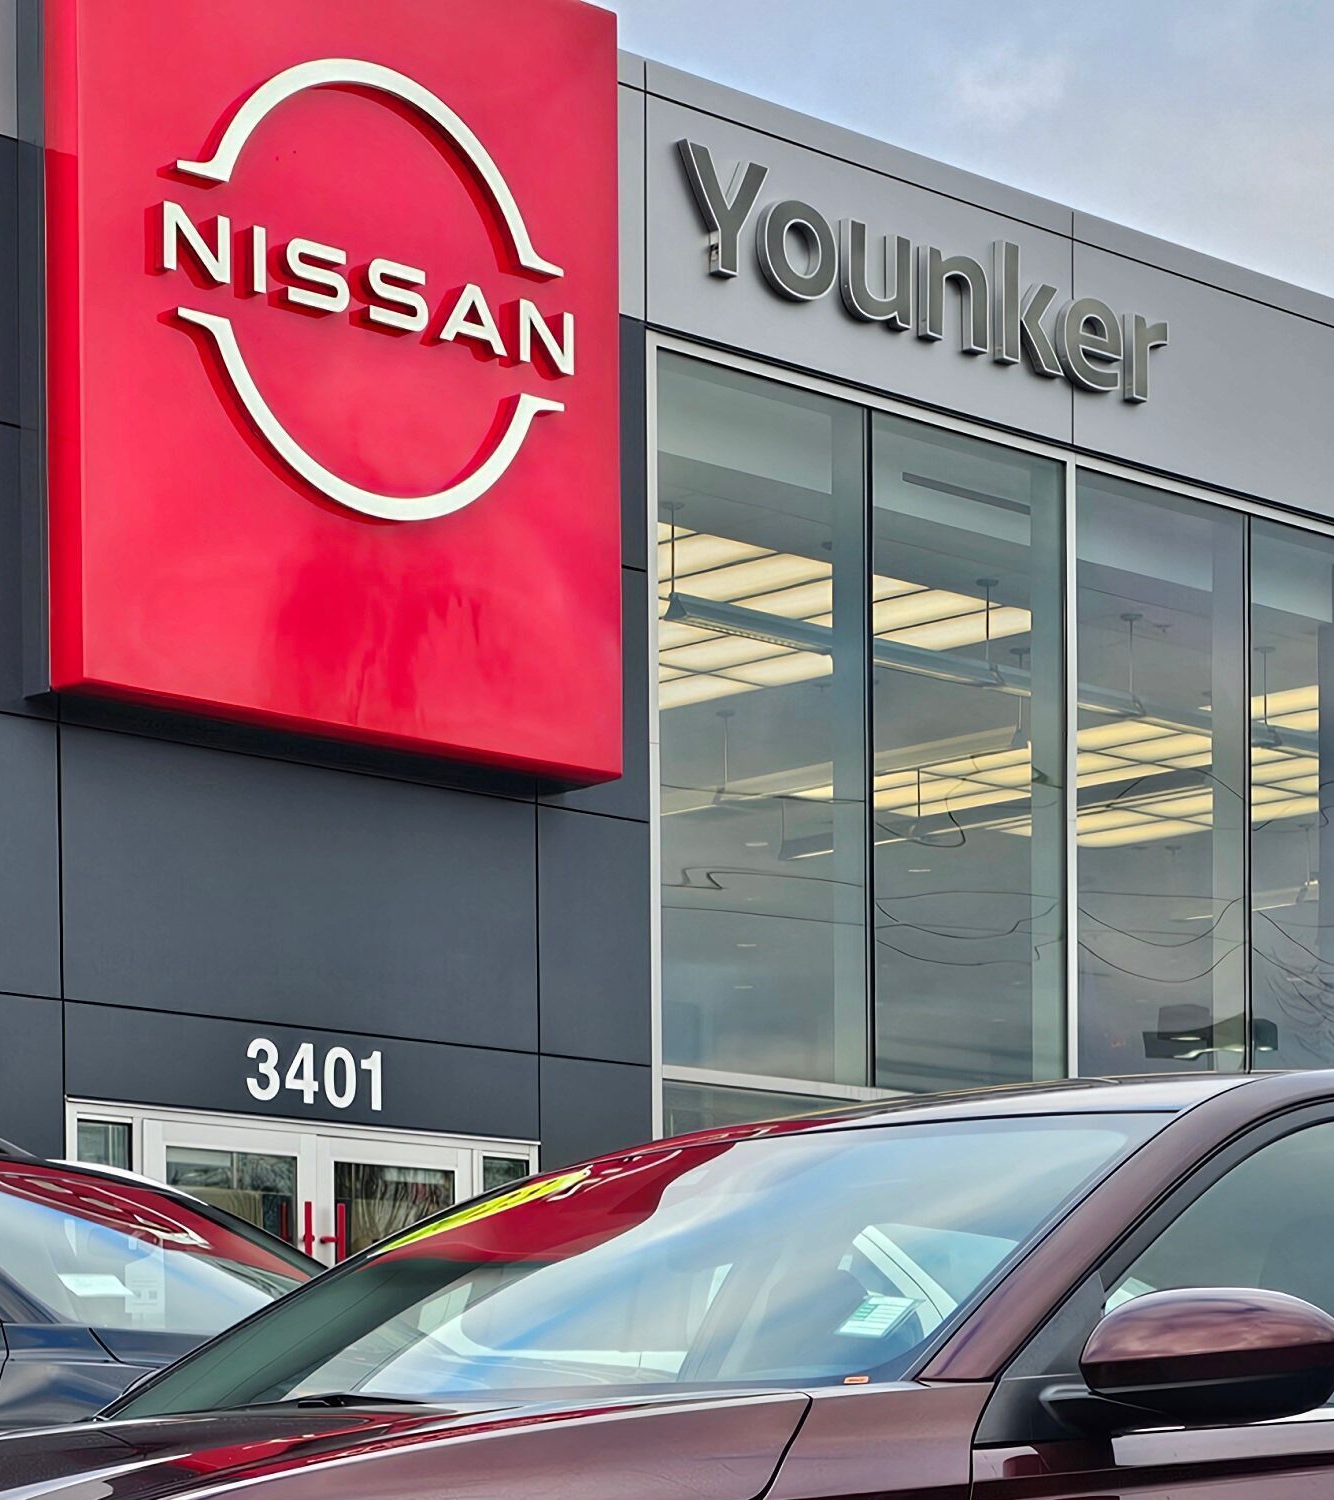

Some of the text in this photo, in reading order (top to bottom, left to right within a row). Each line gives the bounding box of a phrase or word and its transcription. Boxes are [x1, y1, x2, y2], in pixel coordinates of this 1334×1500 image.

[162, 199, 575, 377] NISSAN
[676, 137, 1168, 404] Younker
[245, 1037, 383, 1111] 3401
